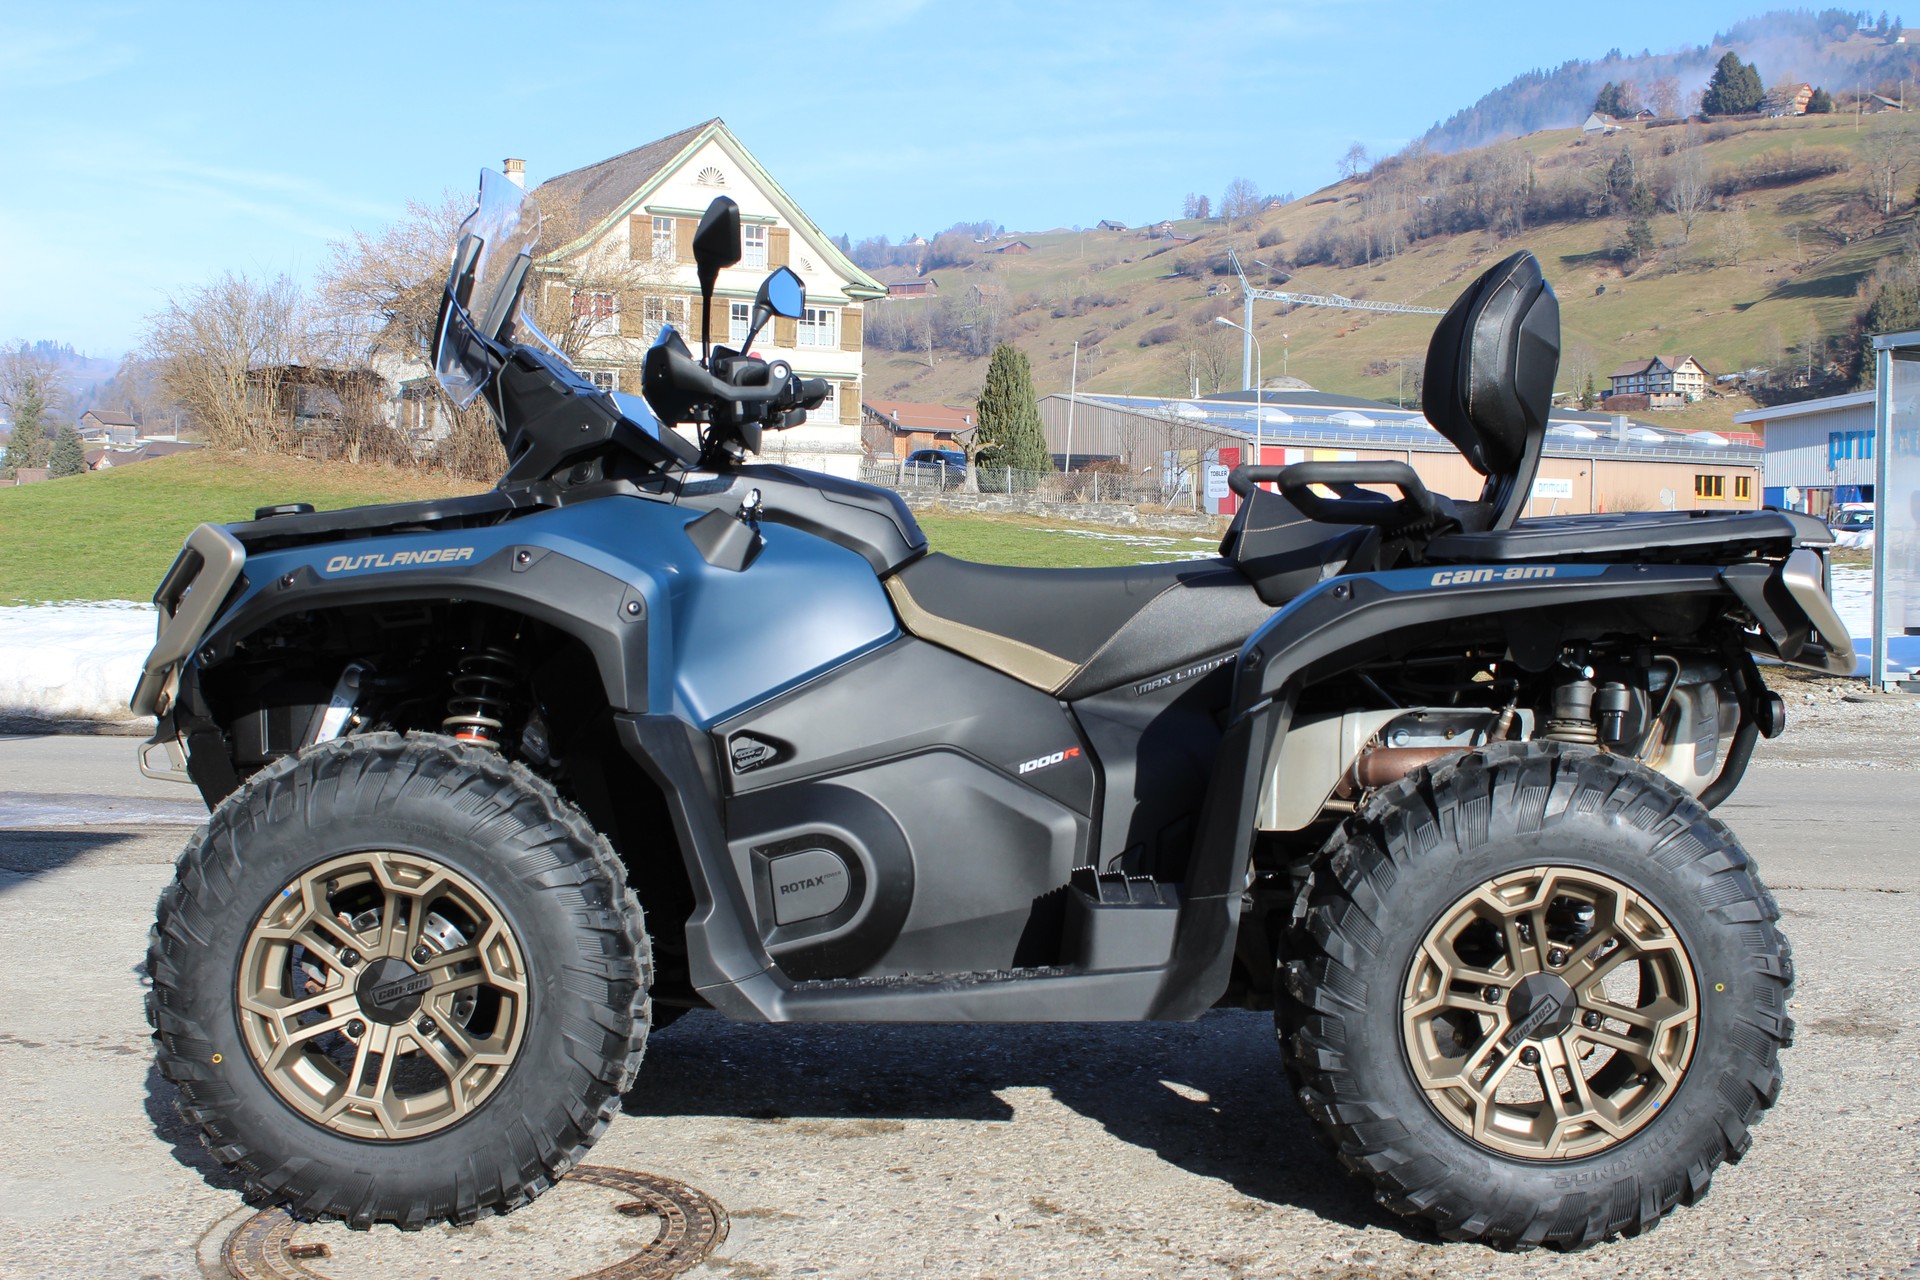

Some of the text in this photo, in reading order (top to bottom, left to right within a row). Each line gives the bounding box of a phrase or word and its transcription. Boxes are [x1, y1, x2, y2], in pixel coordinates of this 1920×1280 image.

[326, 547, 474, 573] OUTLANDER
[1431, 567, 1556, 586] can-am
[1139, 675, 1172, 694] MAX
[1019, 747, 1080, 774] 1000R
[780, 875, 824, 895] ROTAX
[378, 977, 428, 1000] can-am
[1511, 1002, 1553, 1044] can-am
